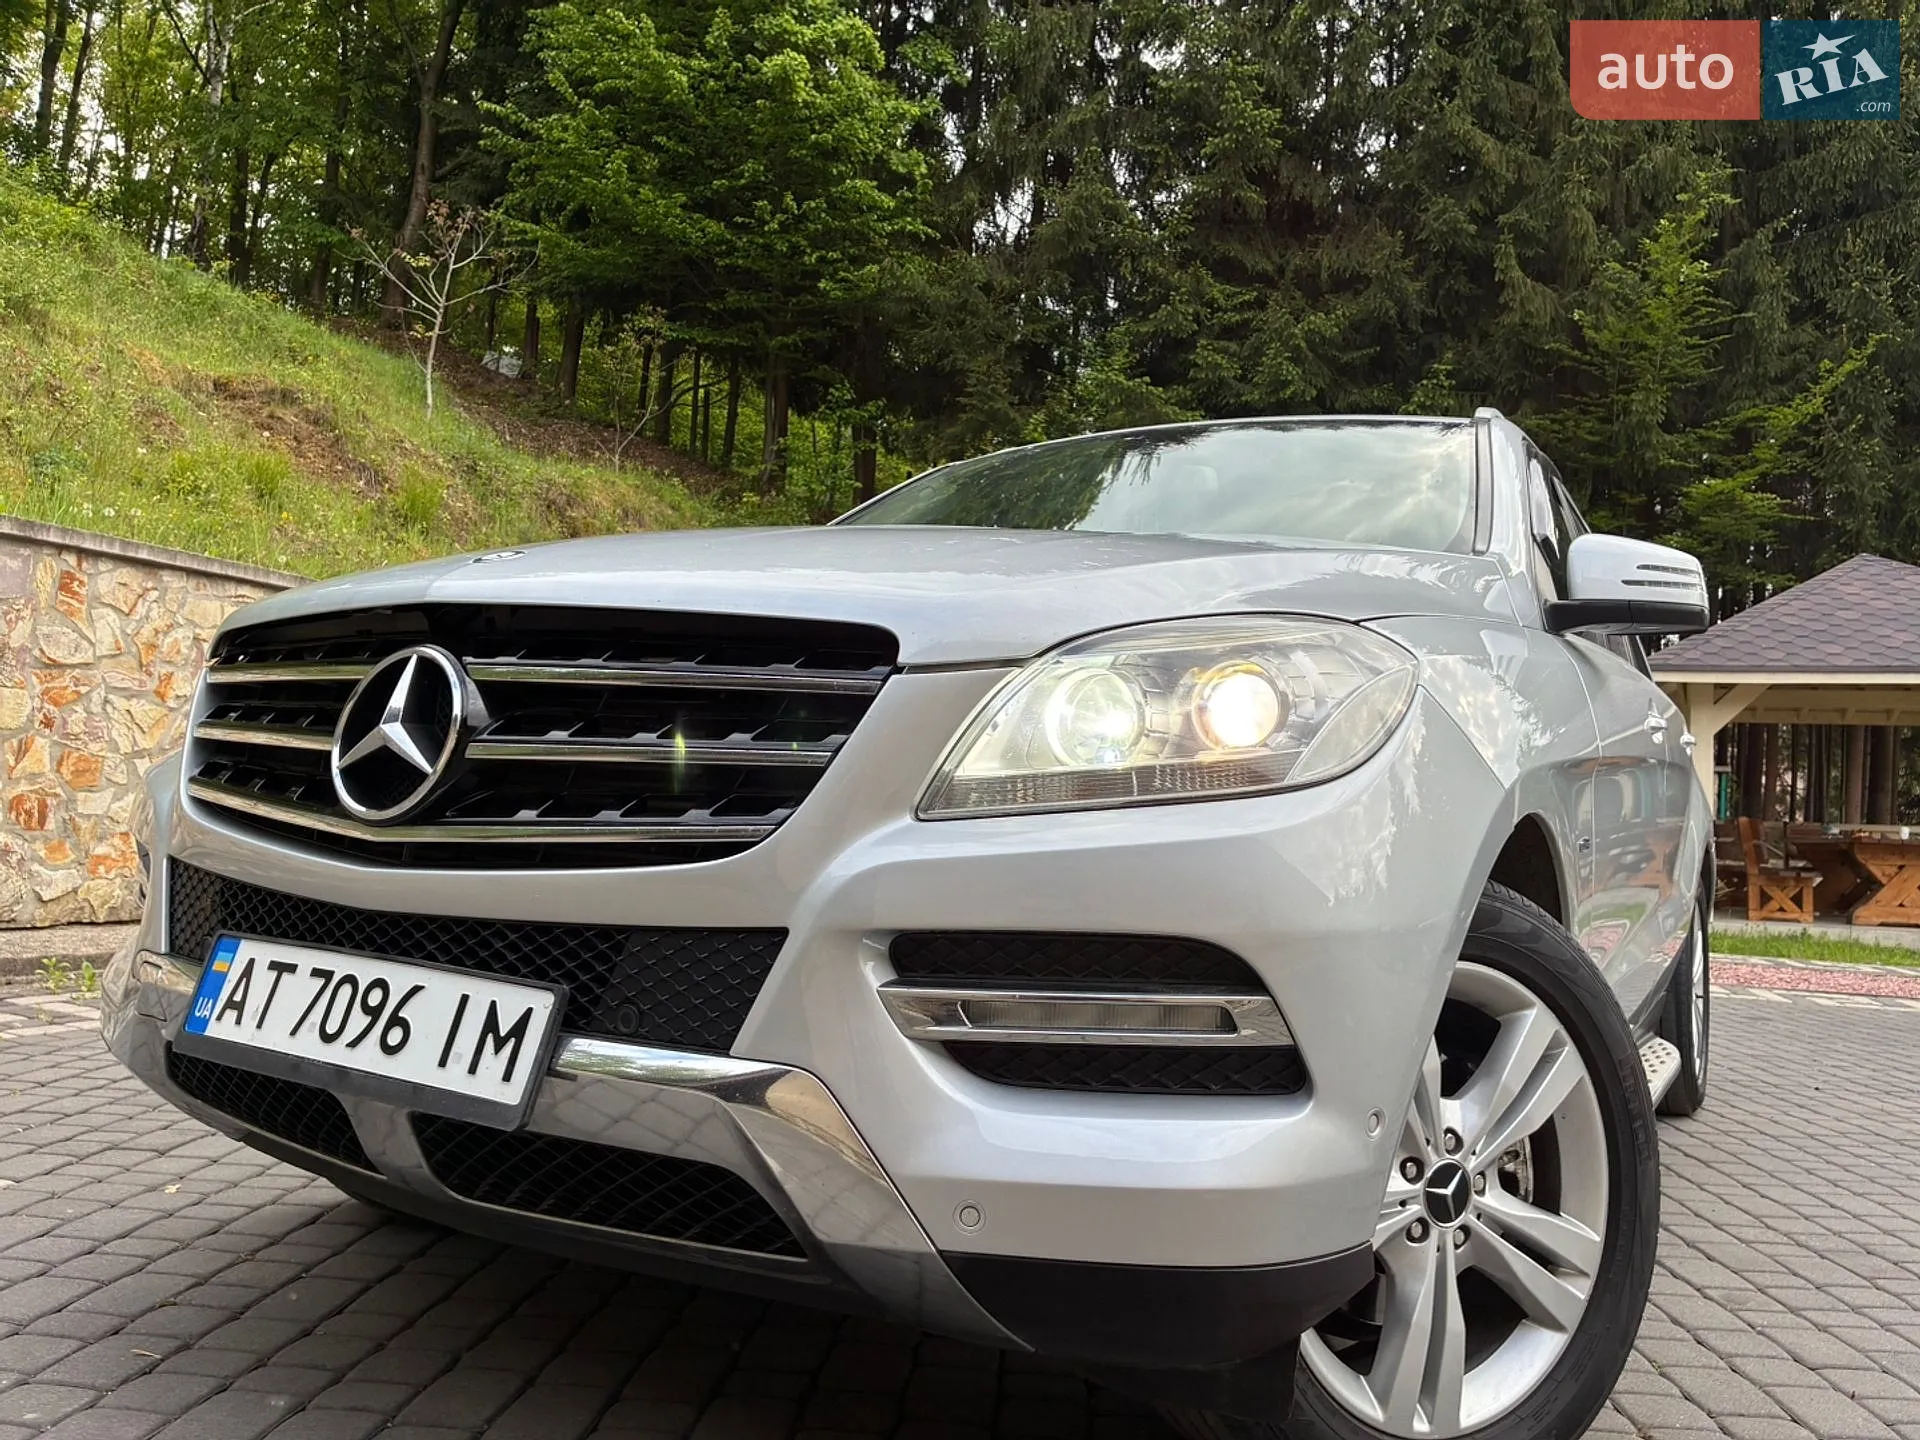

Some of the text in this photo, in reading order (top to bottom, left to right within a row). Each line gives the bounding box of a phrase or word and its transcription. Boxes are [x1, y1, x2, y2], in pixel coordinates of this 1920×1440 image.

[194, 996, 213, 1019] UA
[216, 957, 534, 1083] AT 7096 IM
